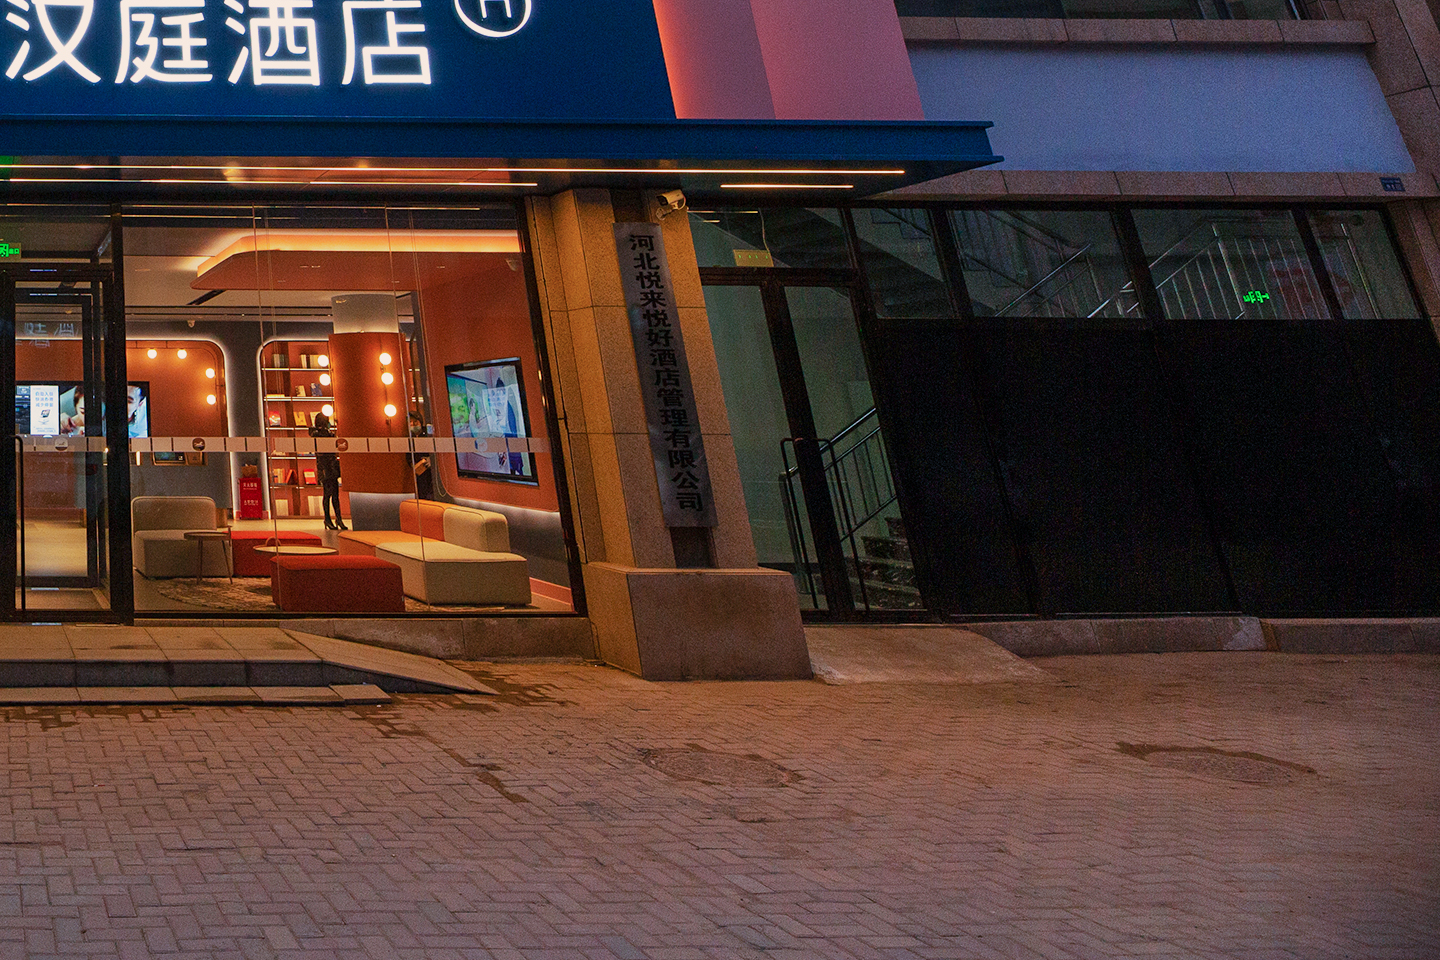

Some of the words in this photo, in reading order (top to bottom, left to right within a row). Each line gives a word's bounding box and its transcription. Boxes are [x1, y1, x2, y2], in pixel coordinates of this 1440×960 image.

[629, 234, 704, 512] 河北悦来悦好酒店管理有限公司
